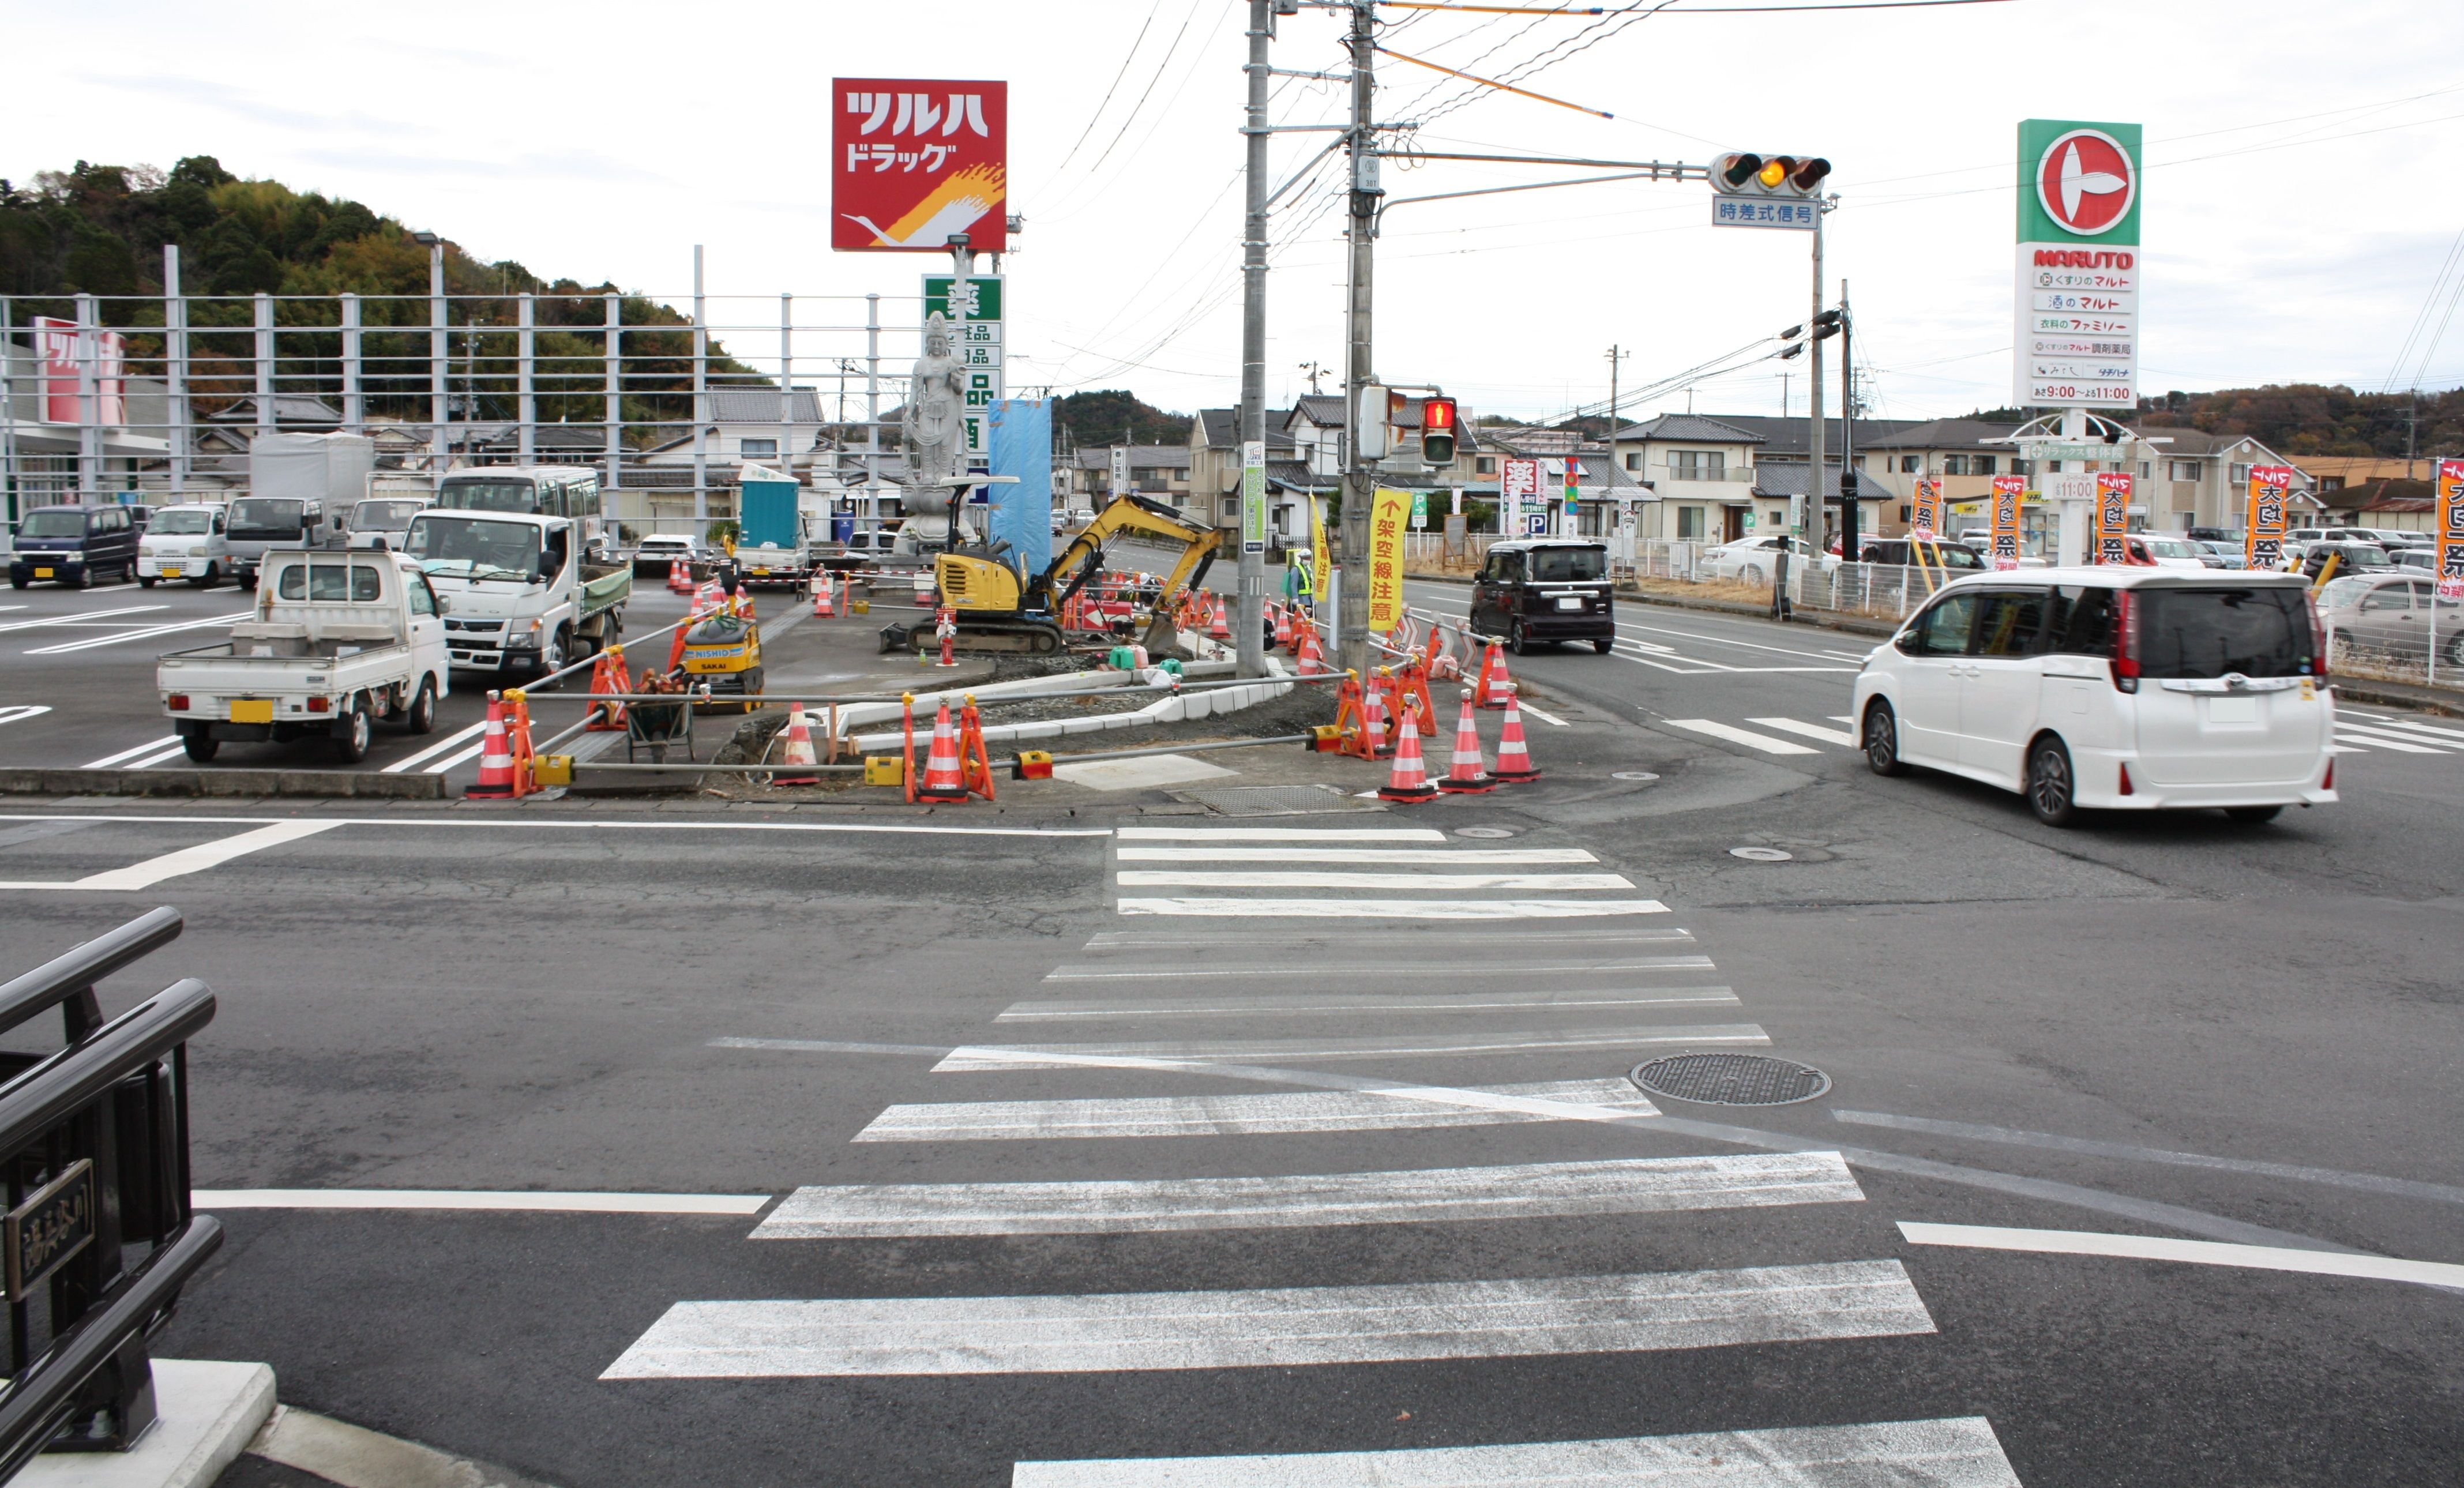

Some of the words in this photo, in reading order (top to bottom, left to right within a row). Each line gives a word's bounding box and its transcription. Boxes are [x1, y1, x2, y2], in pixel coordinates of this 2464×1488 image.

[846, 92, 988, 137] ツルハ
[847, 144, 956, 172] ドラッグ
[1720, 203, 1812, 223] 時差式信号
[2034, 250, 2134, 269] MARUTO
[1506, 461, 1534, 491] 薬
[2061, 482, 2092, 497] 11:00
[1416, 495, 1424, 505] P
[1531, 517, 1544, 532] P
[1747, 516, 1753, 525] P
[1370, 518, 1395, 621] 架空線注意
